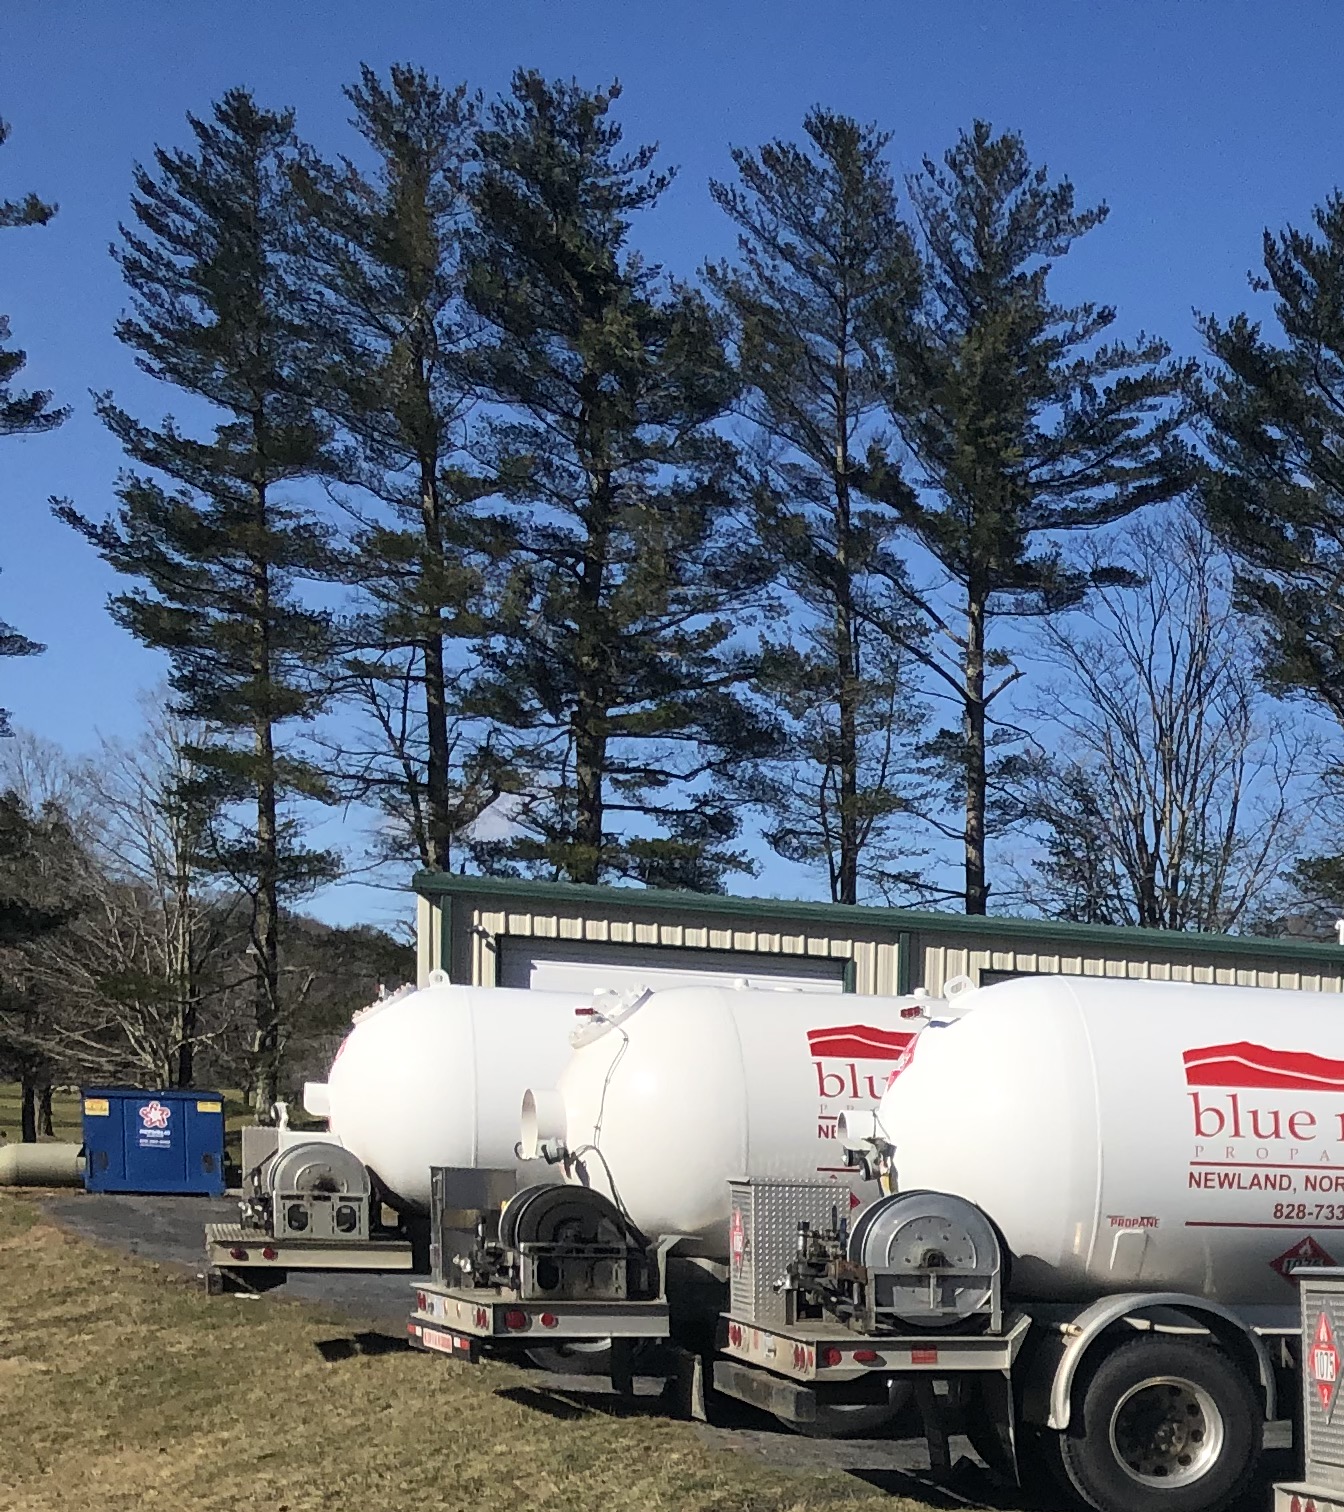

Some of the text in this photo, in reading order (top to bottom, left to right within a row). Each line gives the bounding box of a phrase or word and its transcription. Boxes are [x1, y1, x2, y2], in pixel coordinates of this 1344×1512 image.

[812, 1061, 889, 1100] blu
[1187, 1091, 1317, 1141] blue
[1188, 1171, 1298, 1195] NEWLAND,
[1110, 1216, 1160, 1229] PROPANE
[1315, 1350, 1335, 1380] 1075
